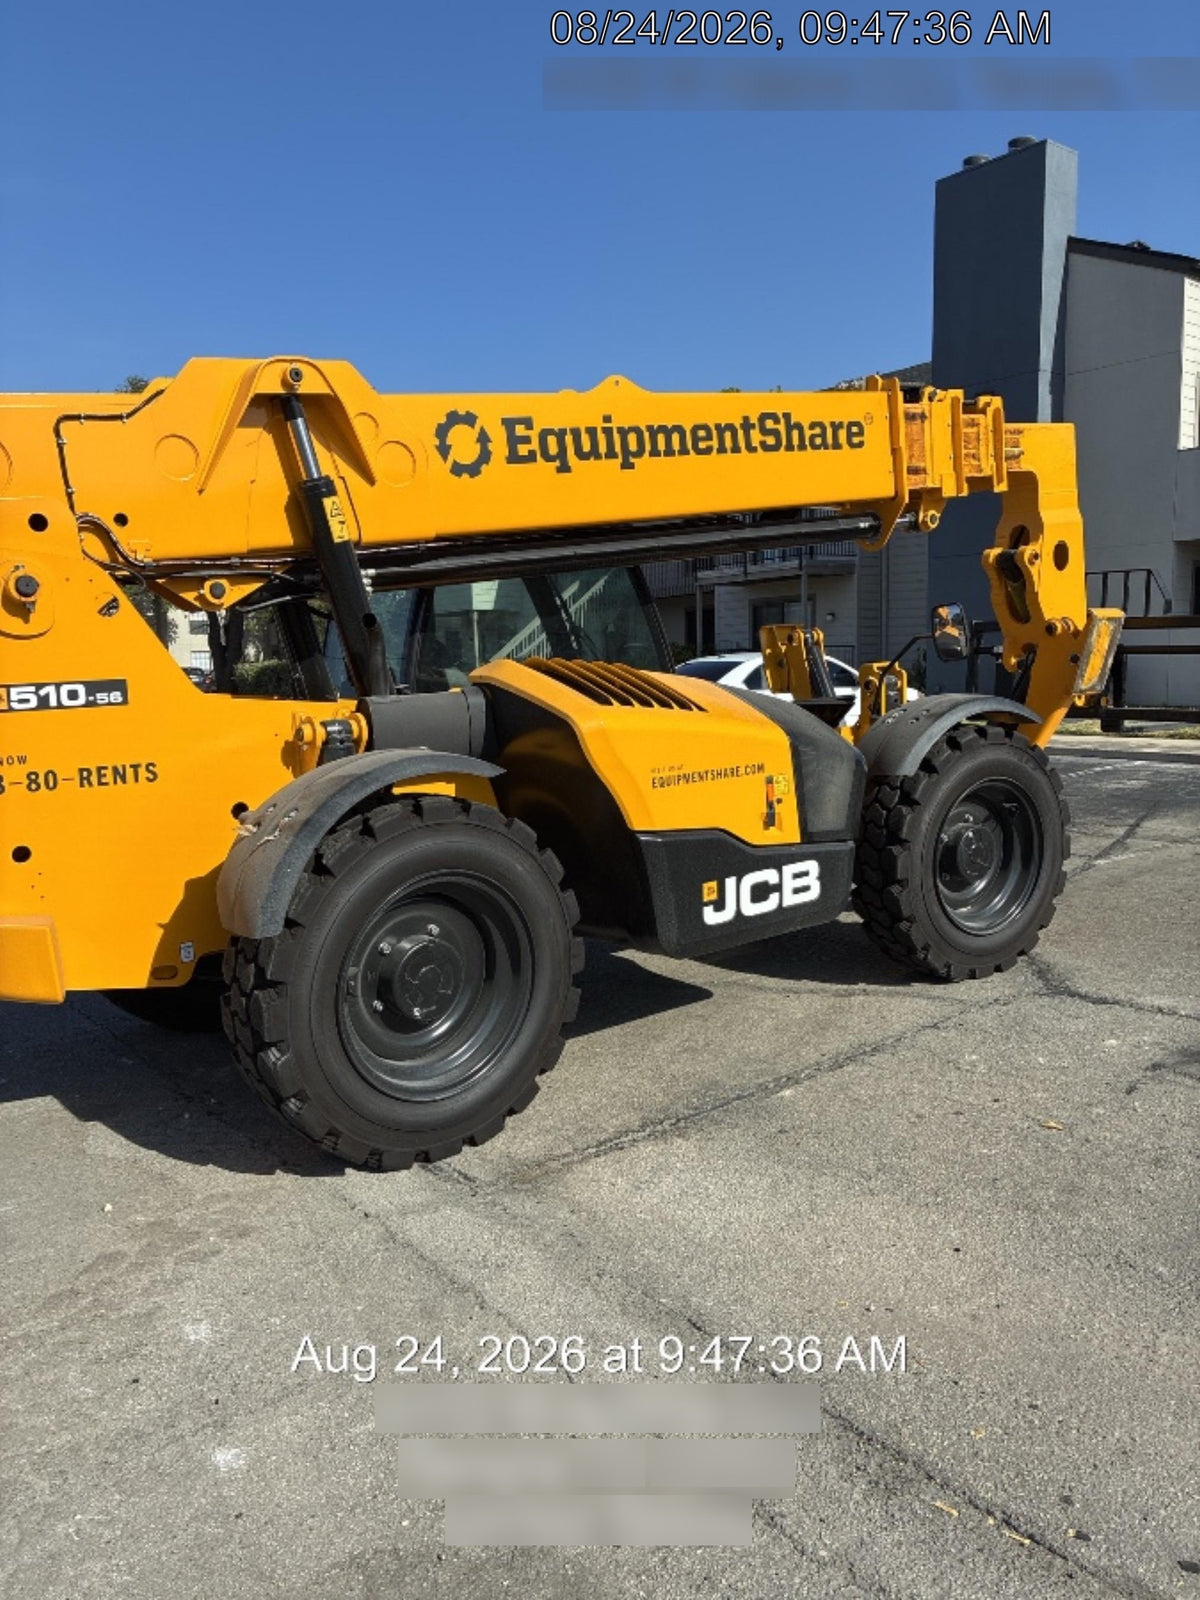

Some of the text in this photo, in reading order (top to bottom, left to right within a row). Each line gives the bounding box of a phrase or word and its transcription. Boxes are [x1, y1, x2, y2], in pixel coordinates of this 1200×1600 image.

[501, 412, 866, 473] EquipmentShare
[9, 683, 124, 710] 510-56
[651, 763, 765, 789] EQUIPMENTSHARE.COM
[702, 859, 821, 926] JCB
